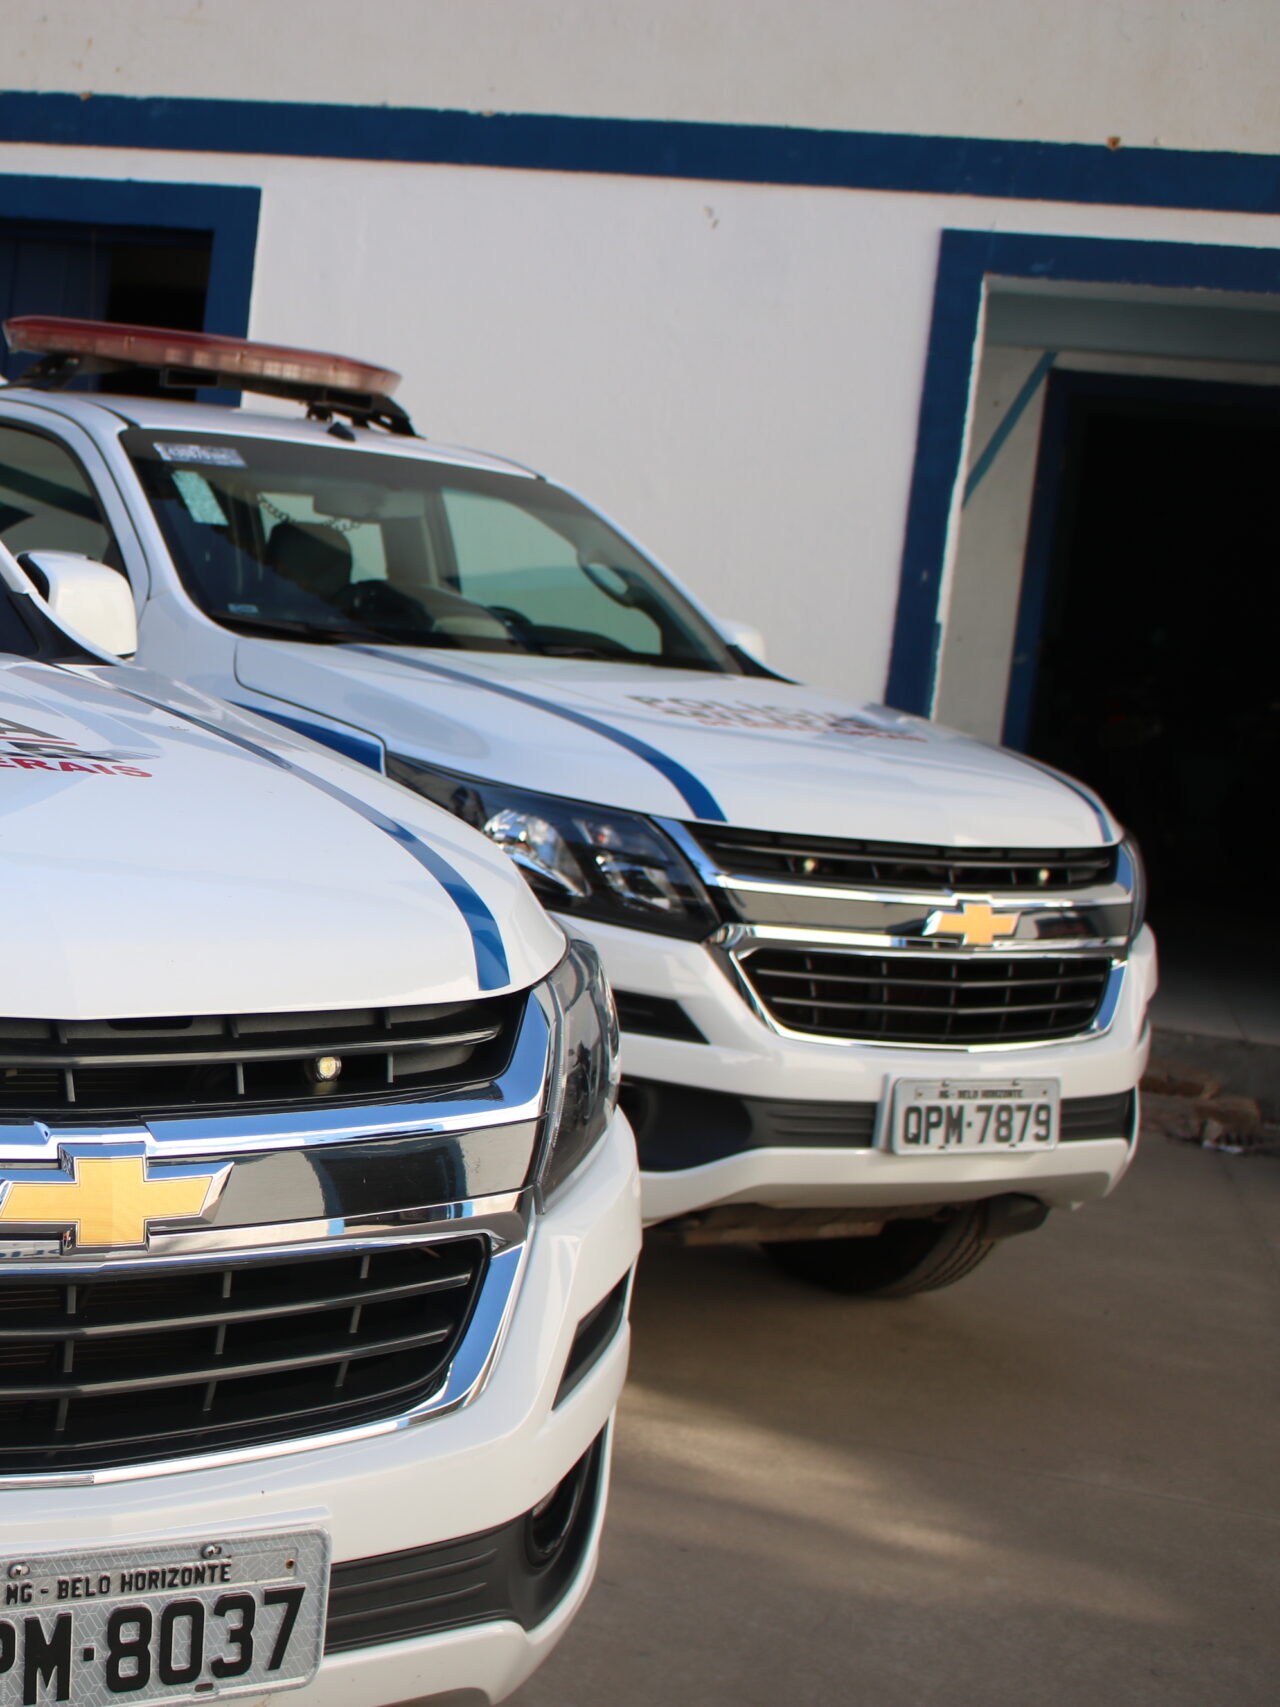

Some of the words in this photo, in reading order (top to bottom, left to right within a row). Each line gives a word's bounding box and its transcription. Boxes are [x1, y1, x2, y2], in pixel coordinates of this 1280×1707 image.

[6, 1581, 32, 1605] MG
[57, 1573, 111, 1600] BELO
[120, 1560, 233, 1593] HORIZONTE
